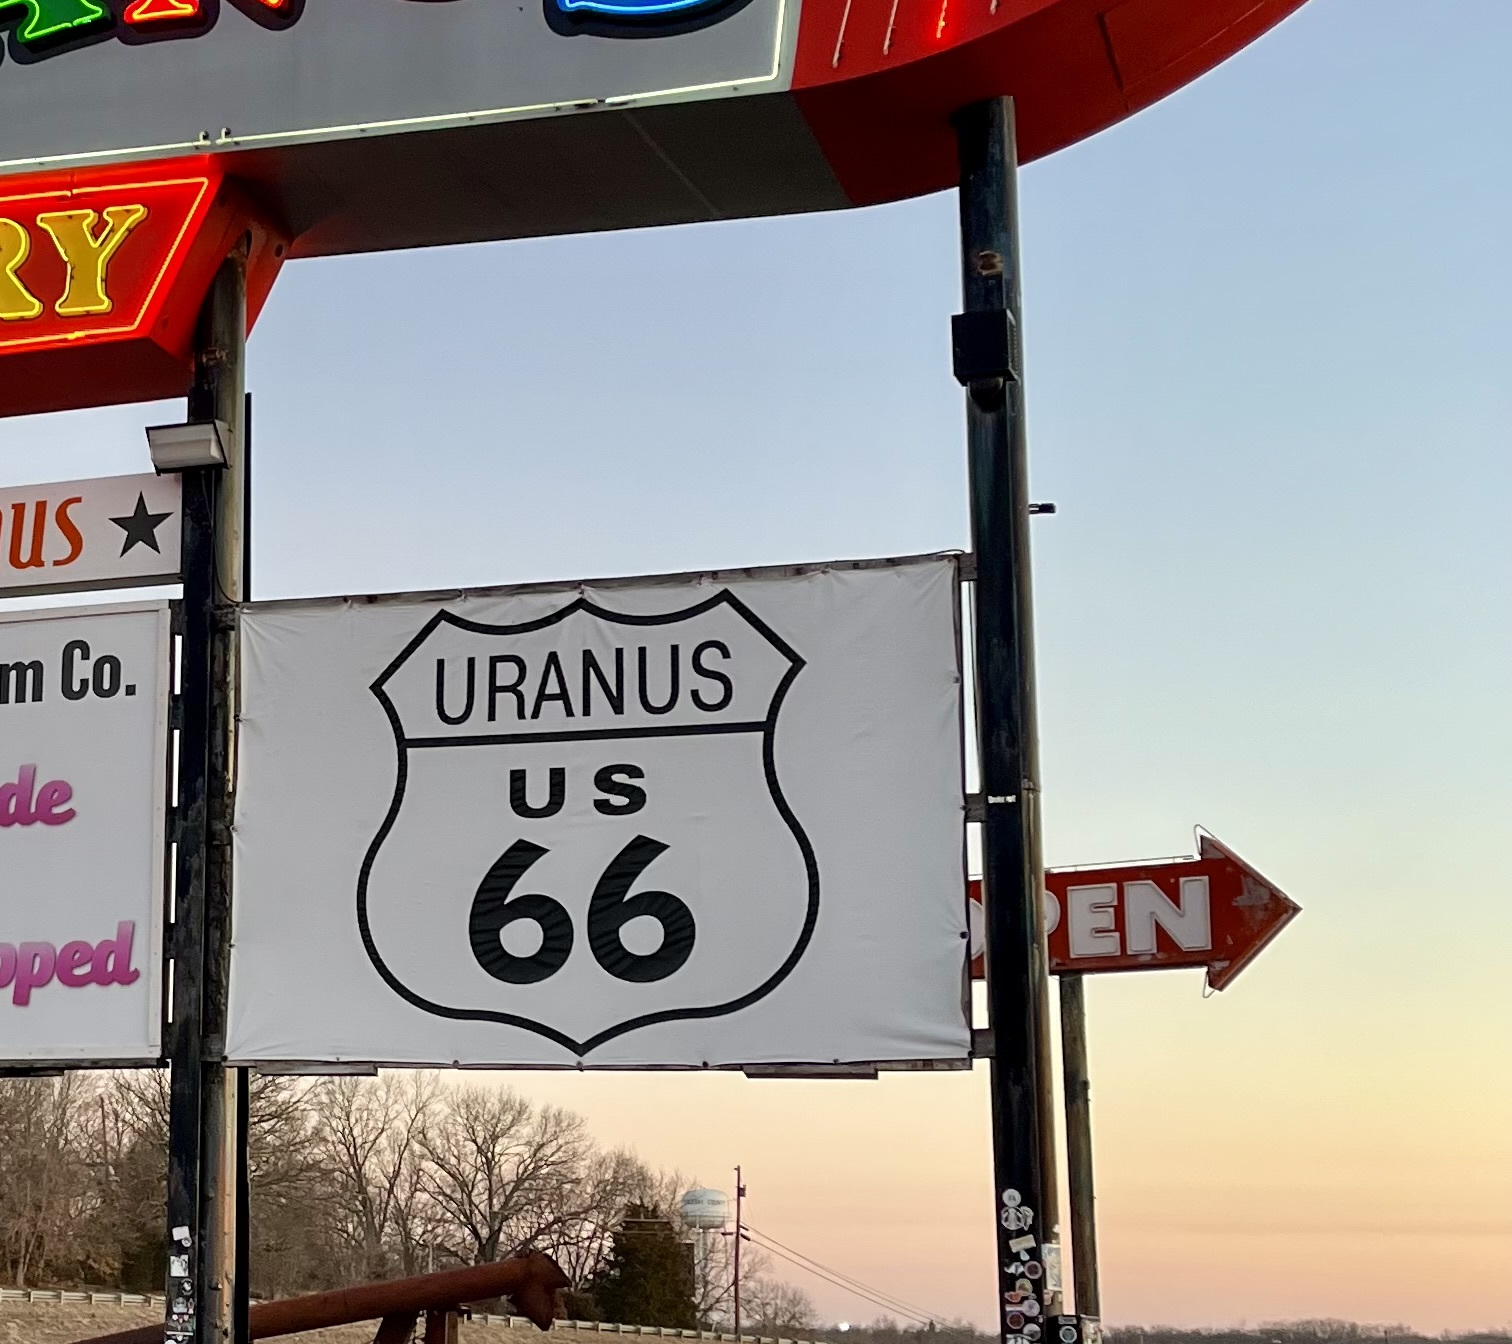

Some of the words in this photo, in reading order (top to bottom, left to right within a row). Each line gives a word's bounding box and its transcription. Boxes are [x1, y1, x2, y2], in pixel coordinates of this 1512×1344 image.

[60, 639, 139, 702] Co.
[434, 638, 734, 726] URANUS
[467, 833, 697, 986] 66
